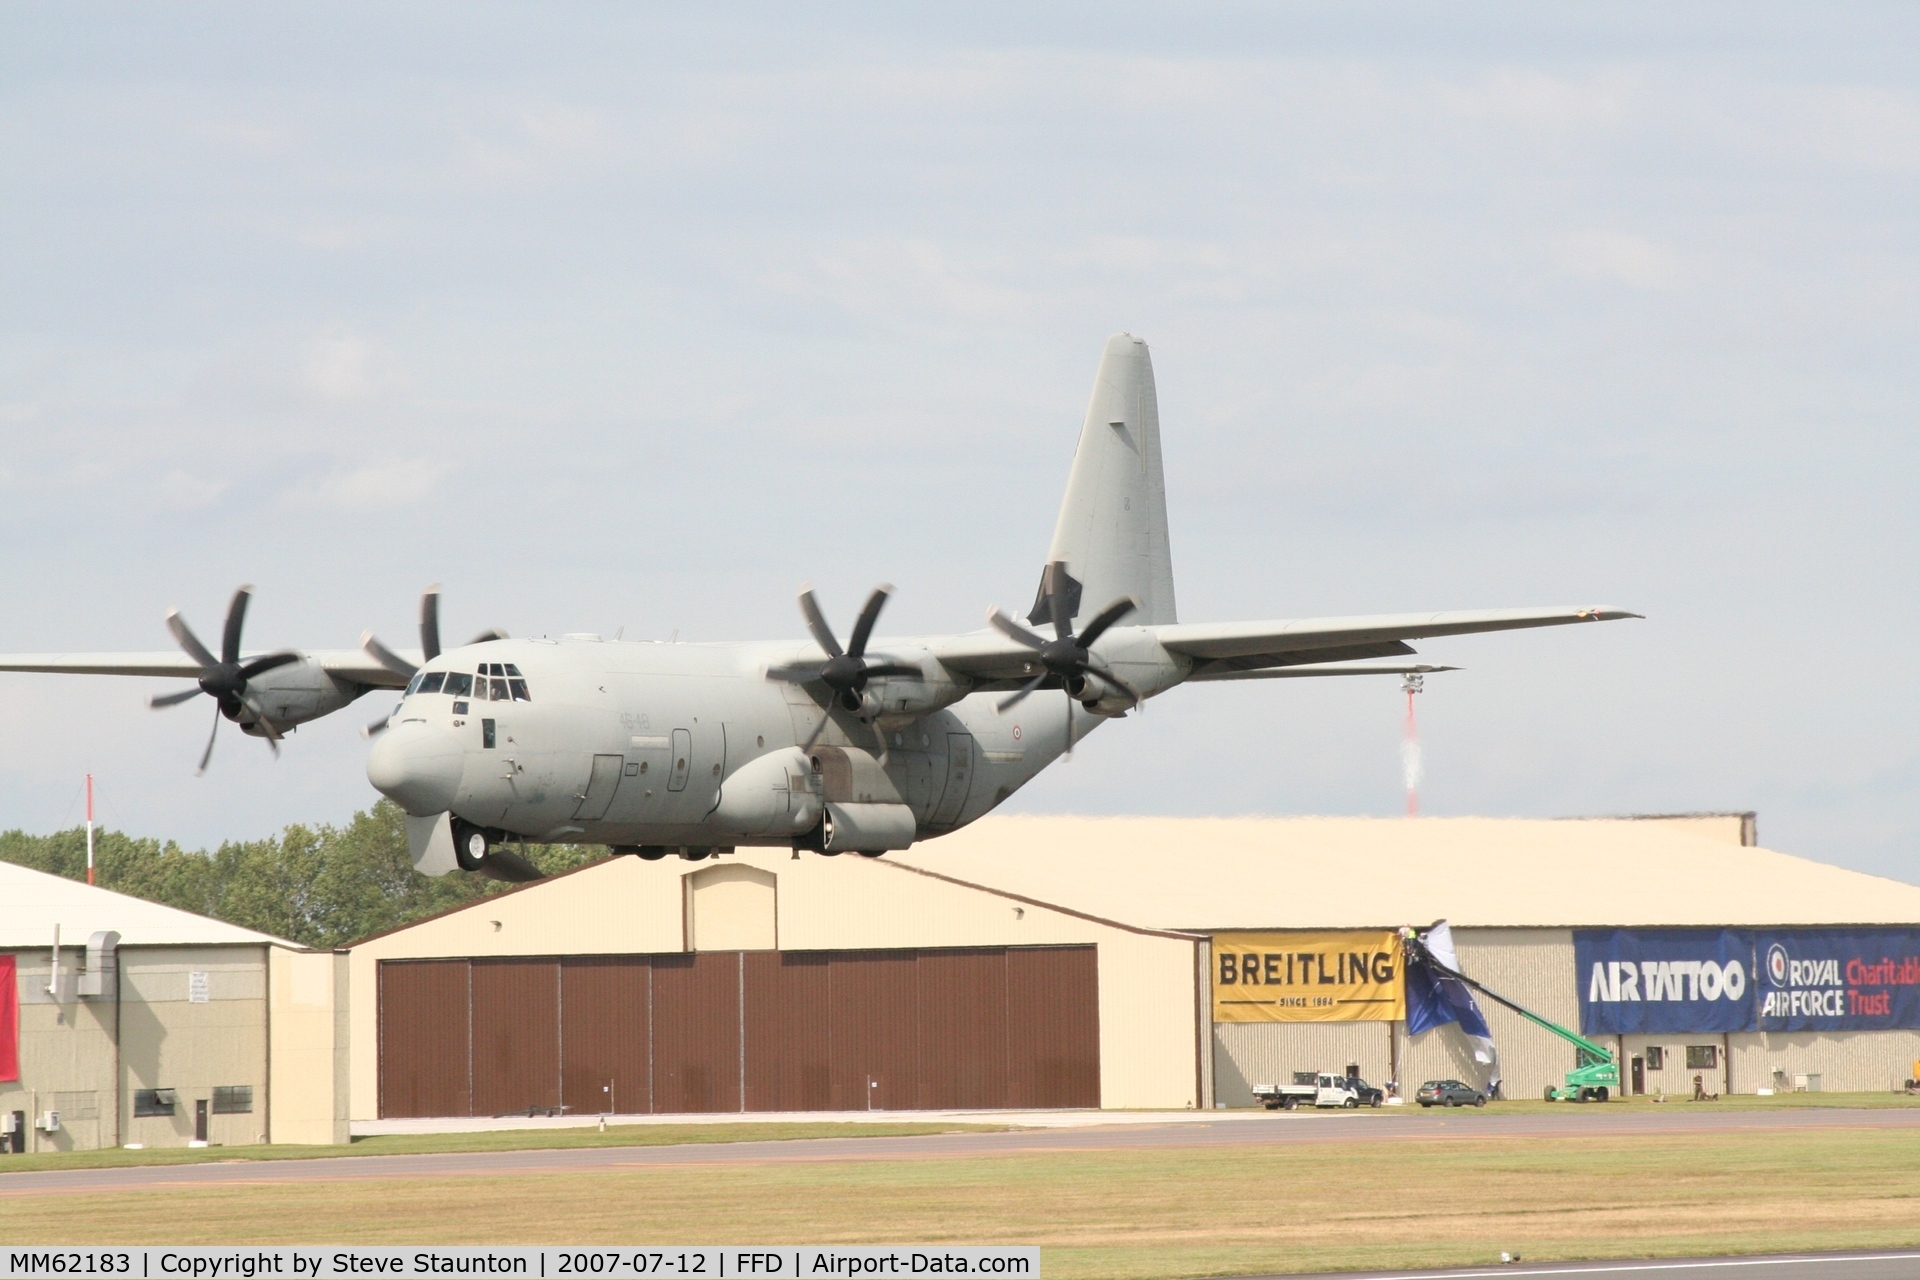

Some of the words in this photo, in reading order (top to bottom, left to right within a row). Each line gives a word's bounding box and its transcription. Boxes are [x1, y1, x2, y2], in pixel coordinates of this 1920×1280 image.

[1219, 952, 1394, 985] BREITLING
[1789, 960, 1843, 986] ROYAL
[1279, 998, 1306, 1007] SINCE
[1313, 997, 1333, 1007] 1884
[1847, 990, 1890, 1015] Trust
